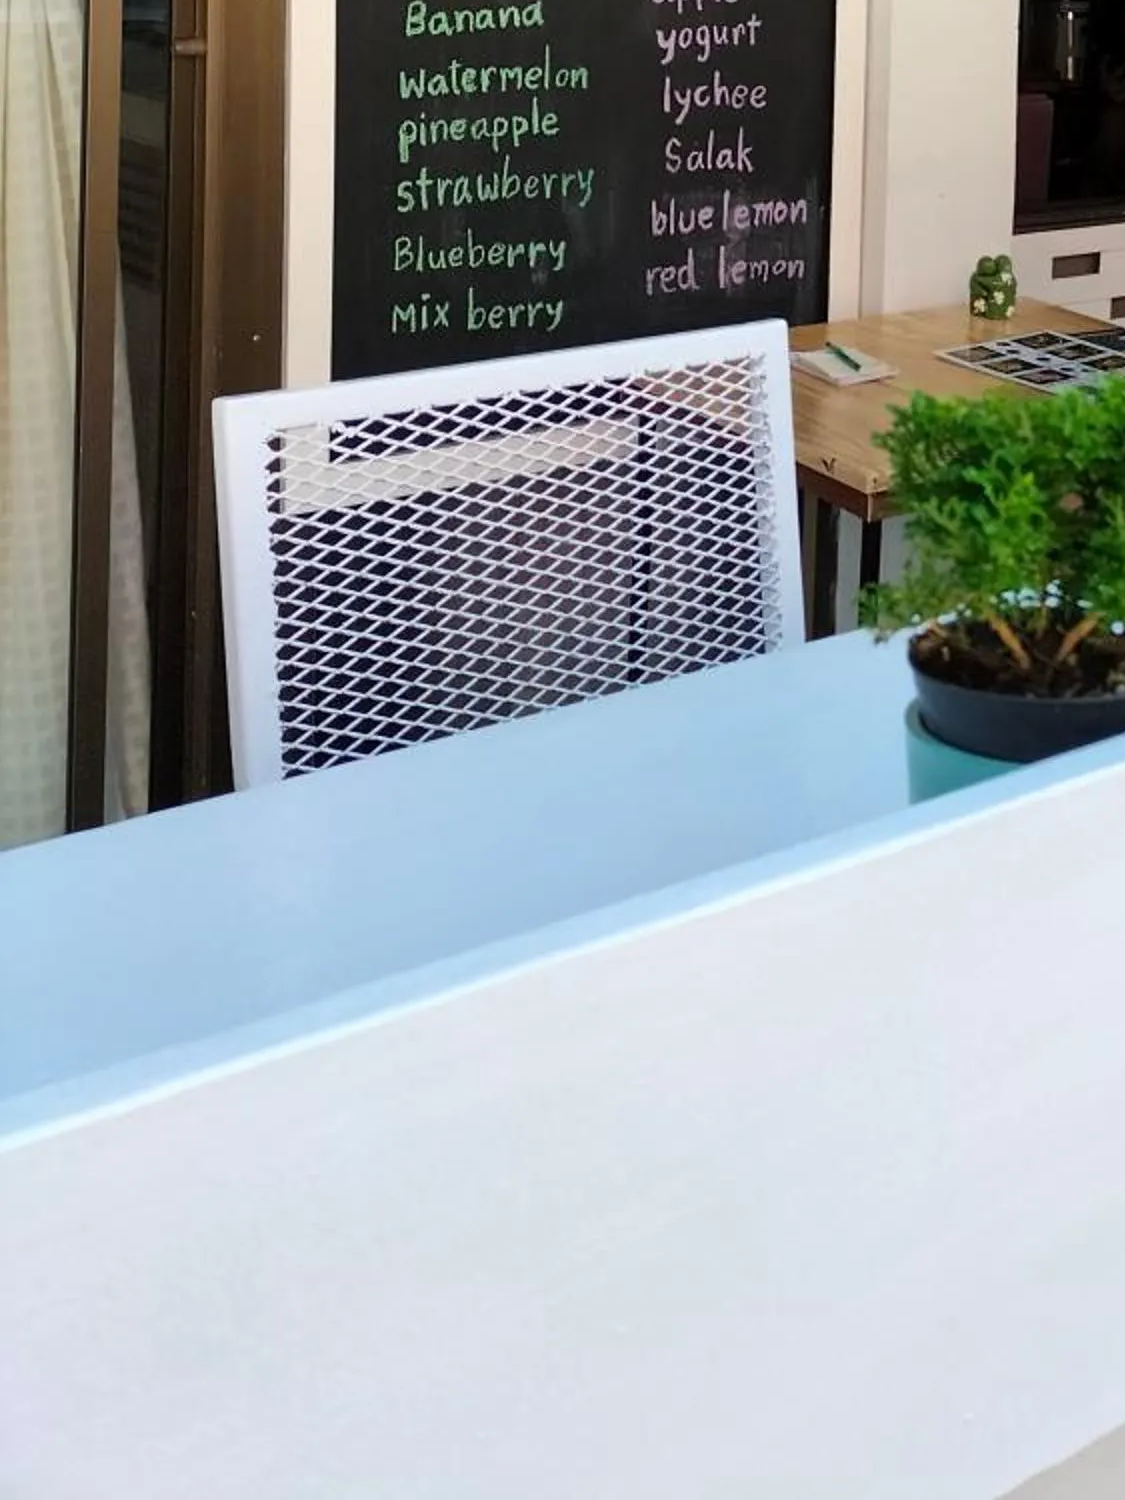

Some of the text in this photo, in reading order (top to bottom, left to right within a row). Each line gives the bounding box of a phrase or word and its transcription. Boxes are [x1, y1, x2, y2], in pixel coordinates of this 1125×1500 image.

[405, 0, 544, 37] Banana
[656, 13, 763, 64] yogurt
[662, 70, 769, 125] lychee
[400, 97, 560, 163] pineapple
[665, 127, 754, 173] Salak
[396, 154, 595, 213] strawberry
[394, 228, 566, 272] Blueberry
[646, 246, 805, 296] red lemon
[468, 288, 564, 333] berry
